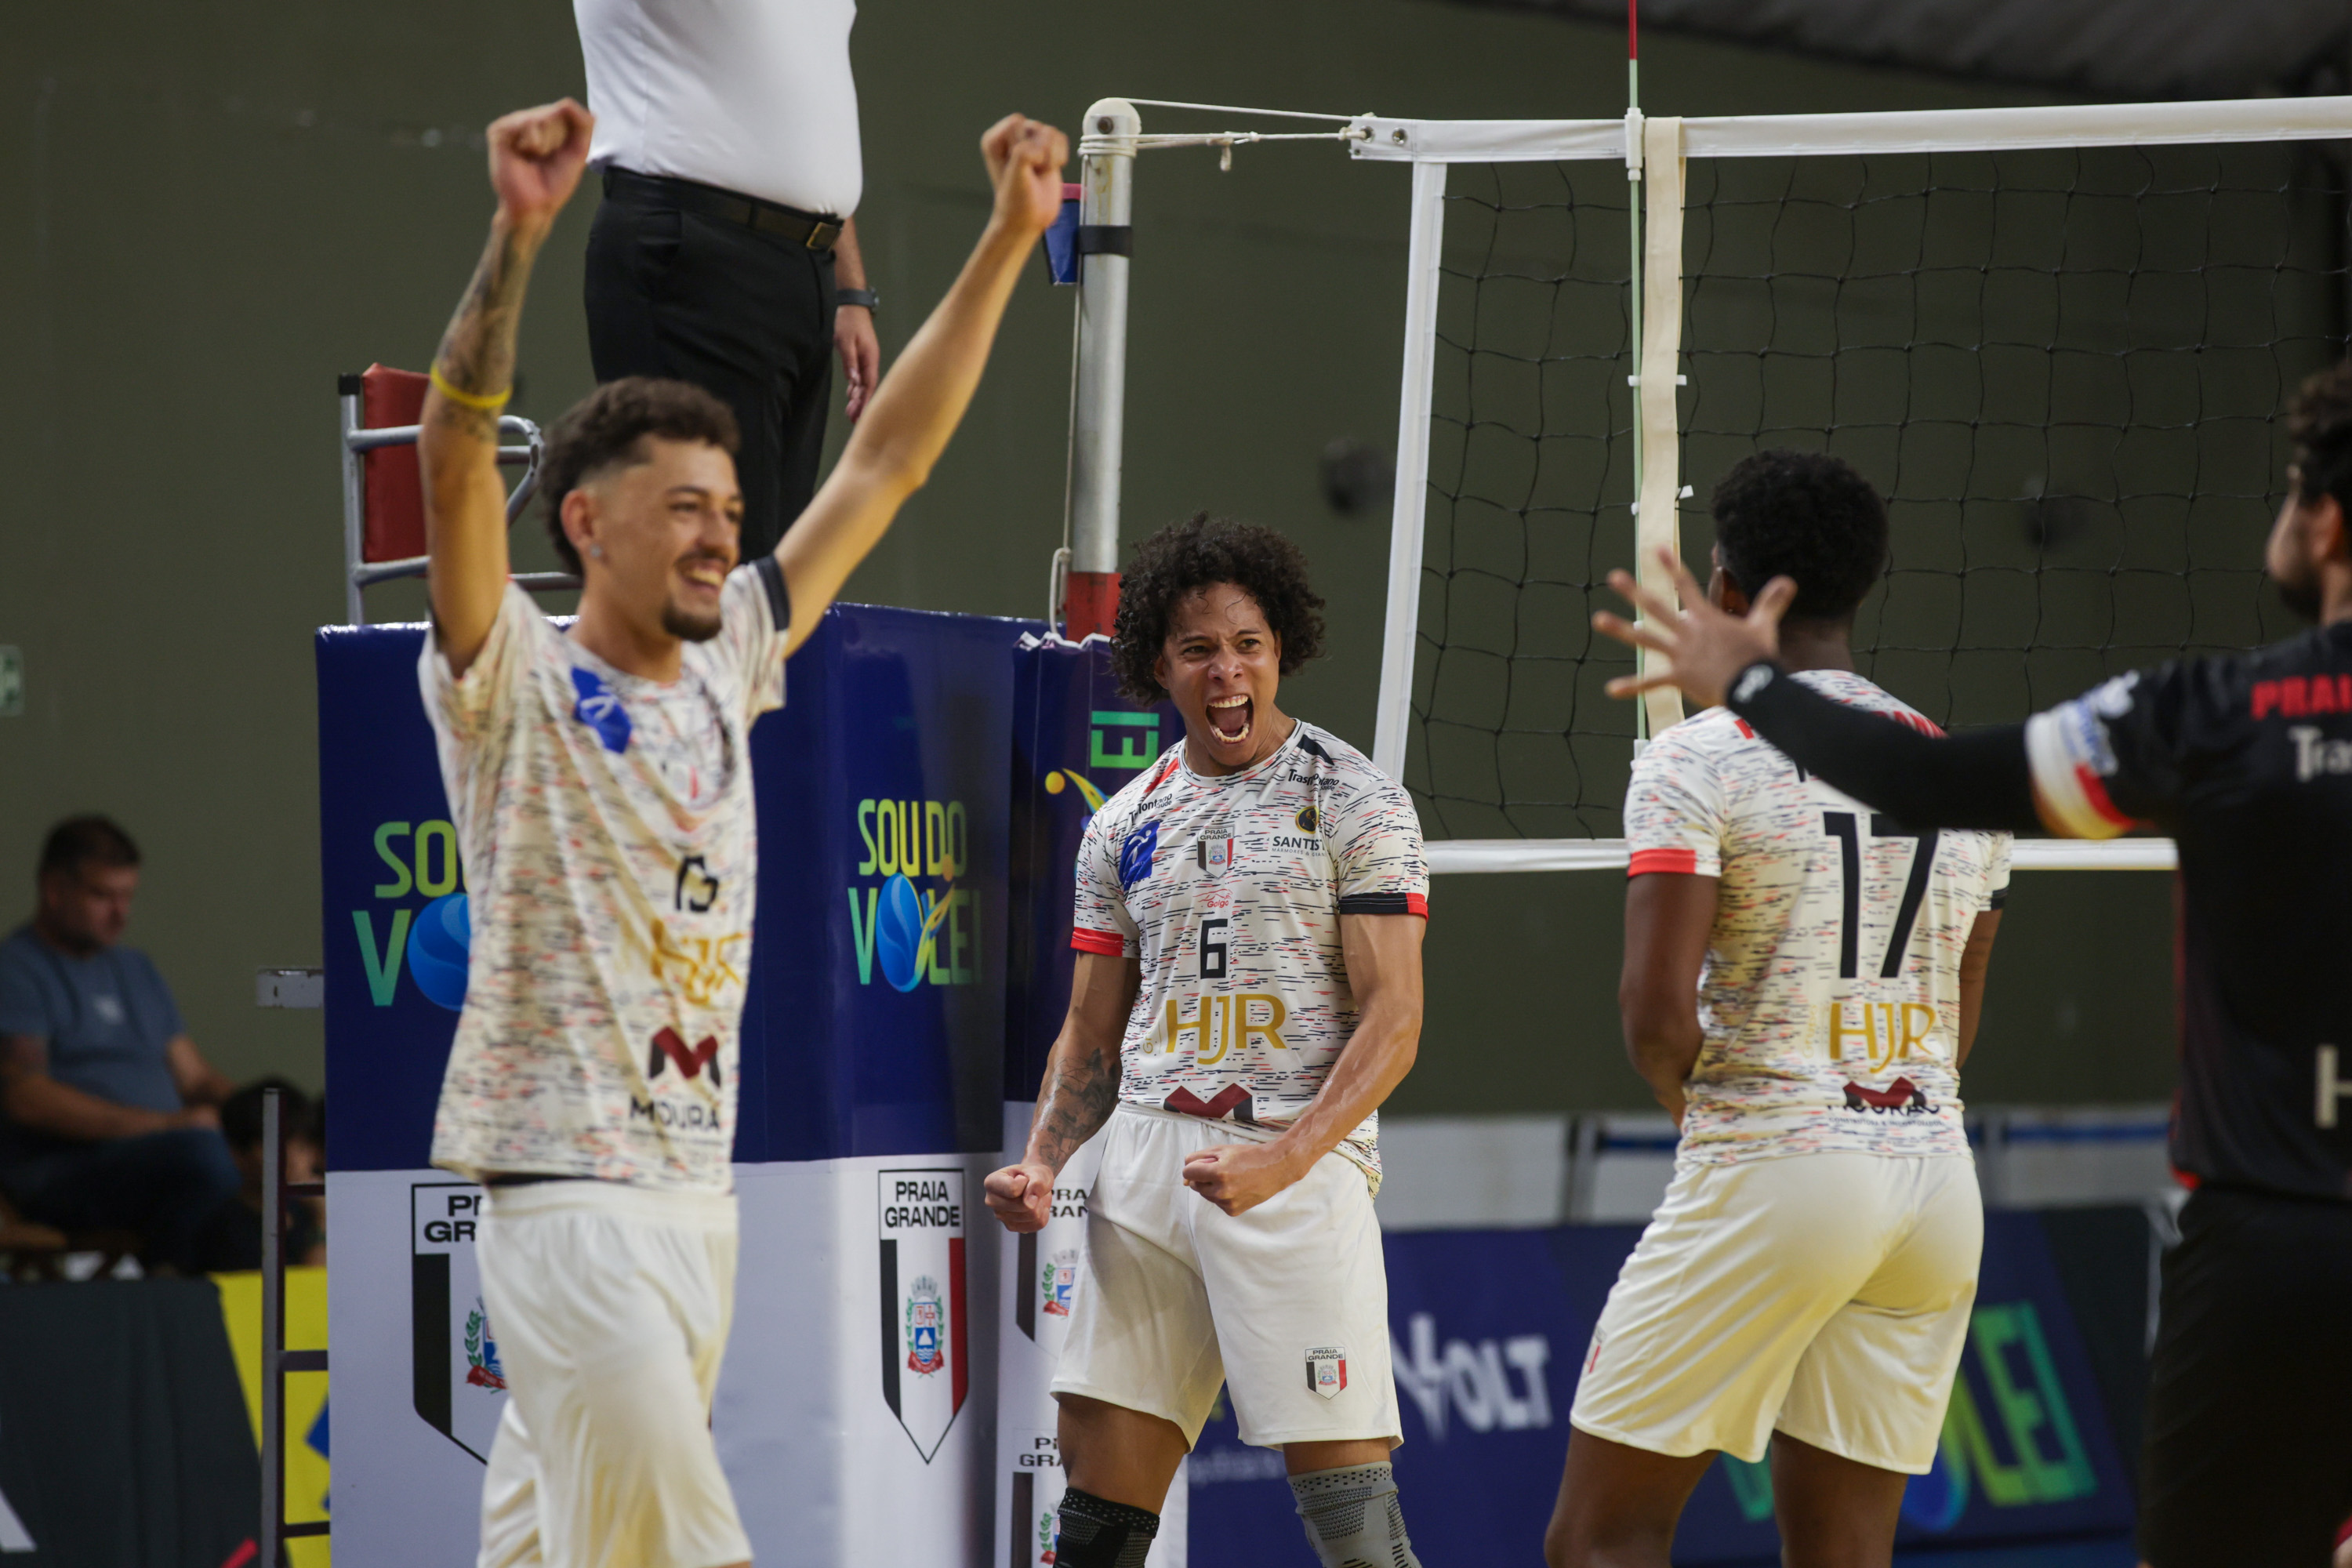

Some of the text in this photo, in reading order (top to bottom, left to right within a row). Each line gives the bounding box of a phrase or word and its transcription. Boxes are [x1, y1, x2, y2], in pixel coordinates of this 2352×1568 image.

[2251, 674, 2352, 720] PRAI
[373, 819, 469, 898] SO
[858, 798, 967, 877] SOU DO
[1823, 811, 1940, 978] 17
[1200, 918, 1228, 979] 6
[1165, 993, 1287, 1065] HJR
[1830, 1002, 1936, 1073] HJR
[885, 1206, 960, 1228] GRANDE
[896, 1181, 949, 1202] PRAIA
